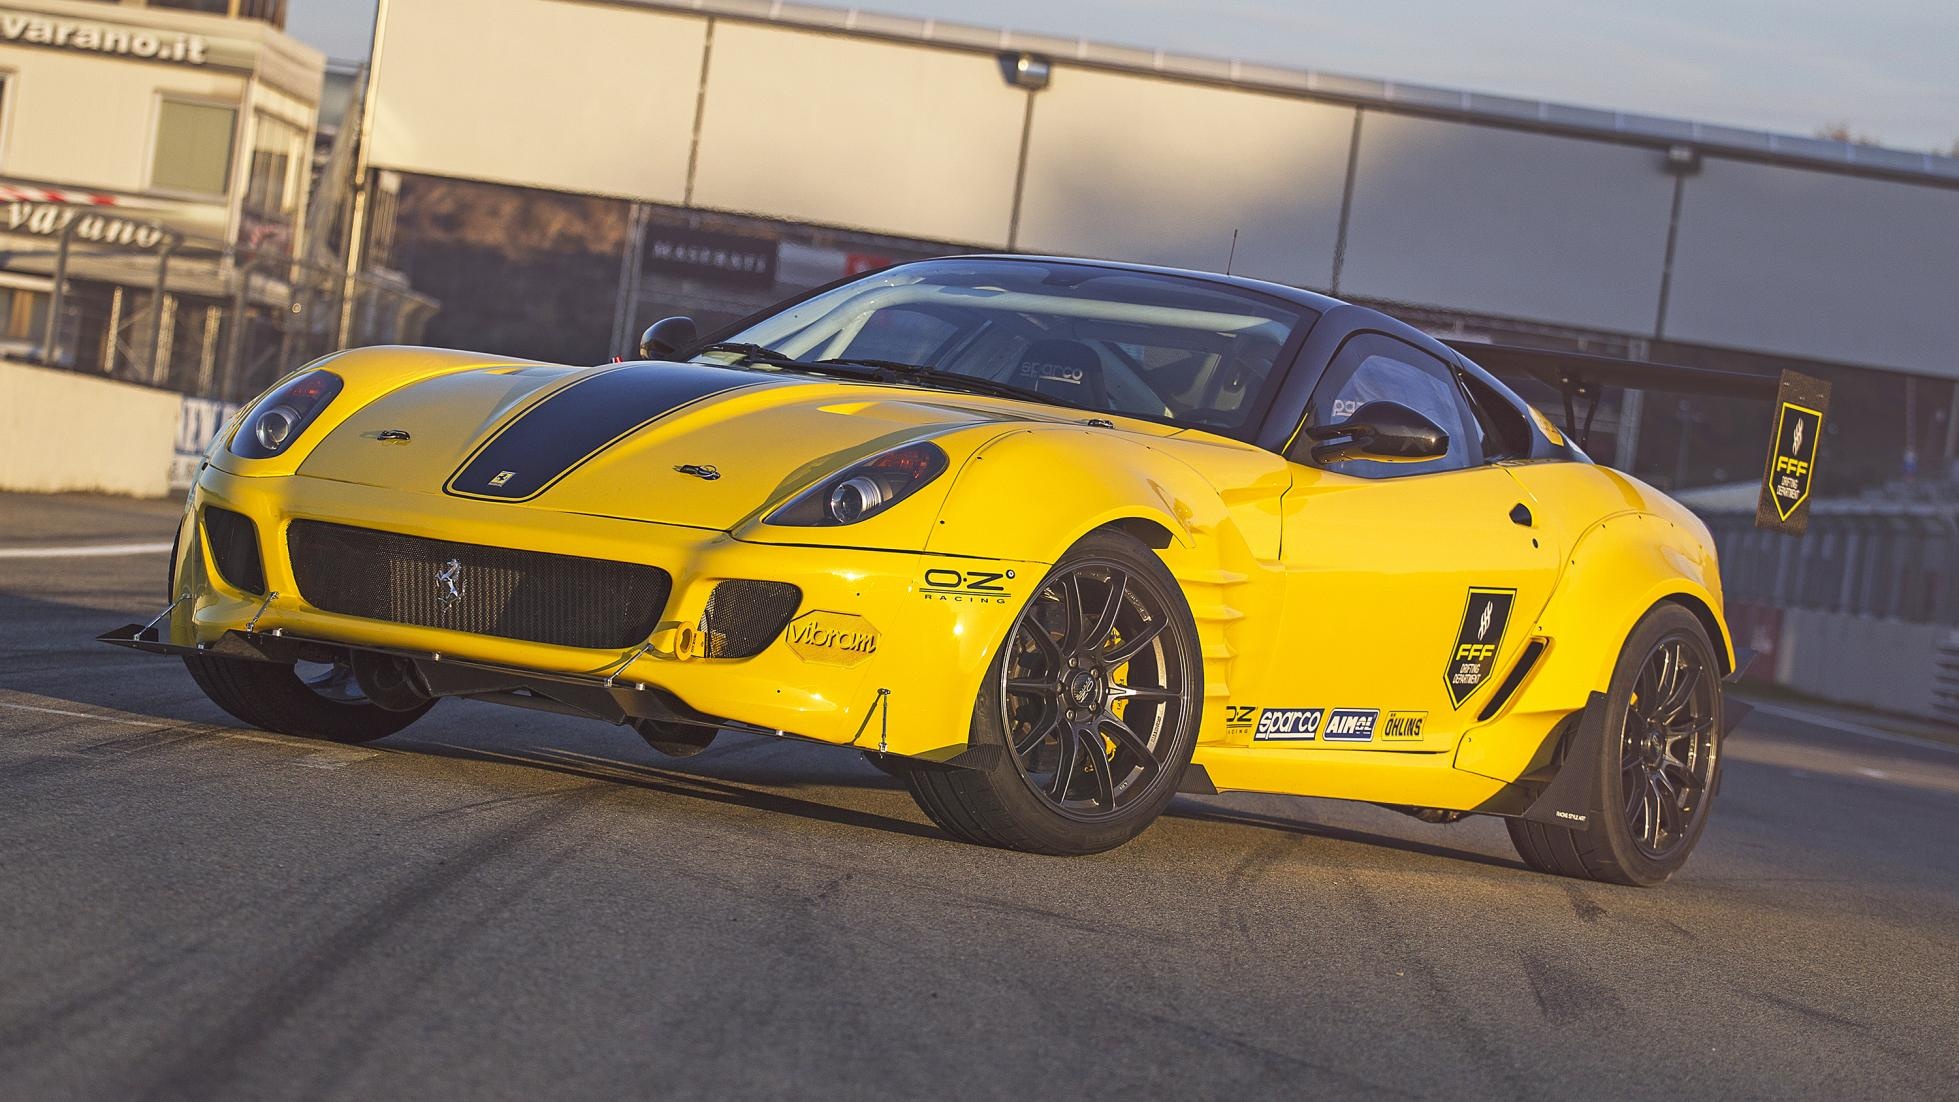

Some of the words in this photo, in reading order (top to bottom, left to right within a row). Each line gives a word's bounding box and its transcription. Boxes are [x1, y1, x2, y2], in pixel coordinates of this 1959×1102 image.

[1, 14, 208, 64] varano.it
[1022, 361, 1083, 380] sparco
[1777, 456, 1809, 477] FFF
[925, 594, 1005, 604] RACING
[1455, 644, 1496, 661] FFF
[1259, 711, 1321, 739] sparco
[1326, 716, 1373, 734] AIMOL
[1384, 713, 1423, 736] ÖHLINS
